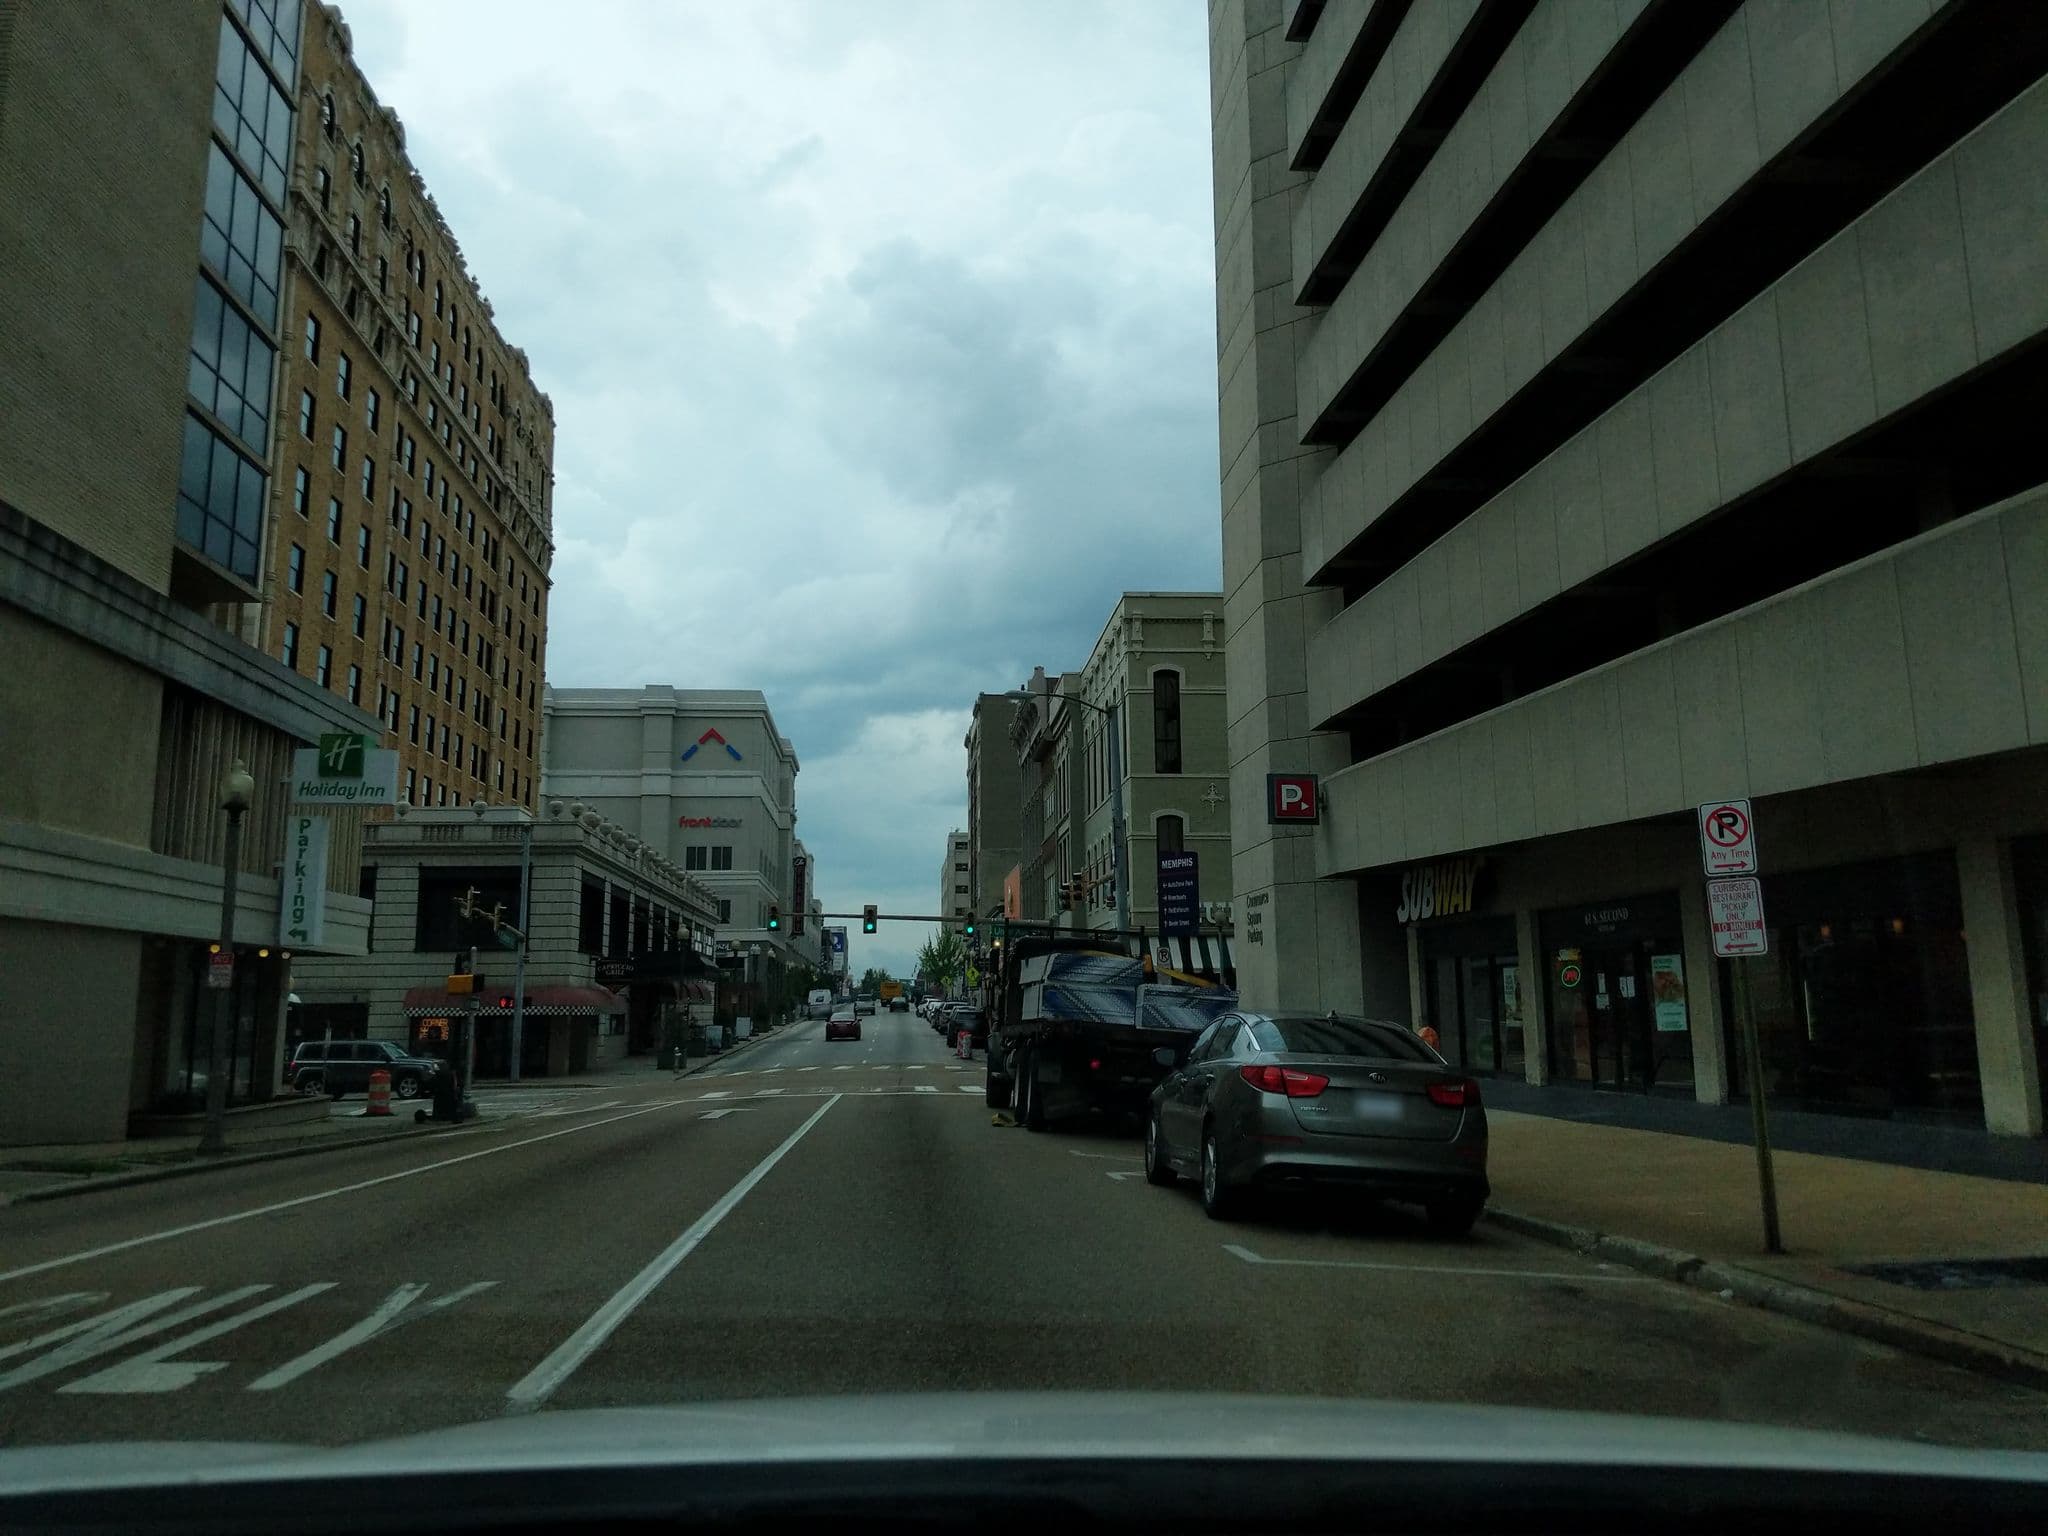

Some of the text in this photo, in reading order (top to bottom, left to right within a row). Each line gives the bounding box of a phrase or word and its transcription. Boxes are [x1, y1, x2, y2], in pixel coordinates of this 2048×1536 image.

[298, 781, 386, 800] Holiday Inn
[1281, 784, 1303, 811] P
[679, 816, 742, 828] frontdoor
[1711, 848, 1750, 860] Any Time
[1161, 857, 1193, 869] MEMPHIS
[291, 818, 311, 924] Parking
[1396, 856, 1484, 925] SUBWAY
[1712, 882, 1751, 893] CURBSIDE
[1712, 891, 1756, 903] RESTAURANT
[1721, 902, 1749, 912] PICKUP
[1726, 911, 1745, 921] ONLY
[1719, 919, 1758, 932] 10 MINUTE
[1730, 930, 1748, 941] LIMIT
